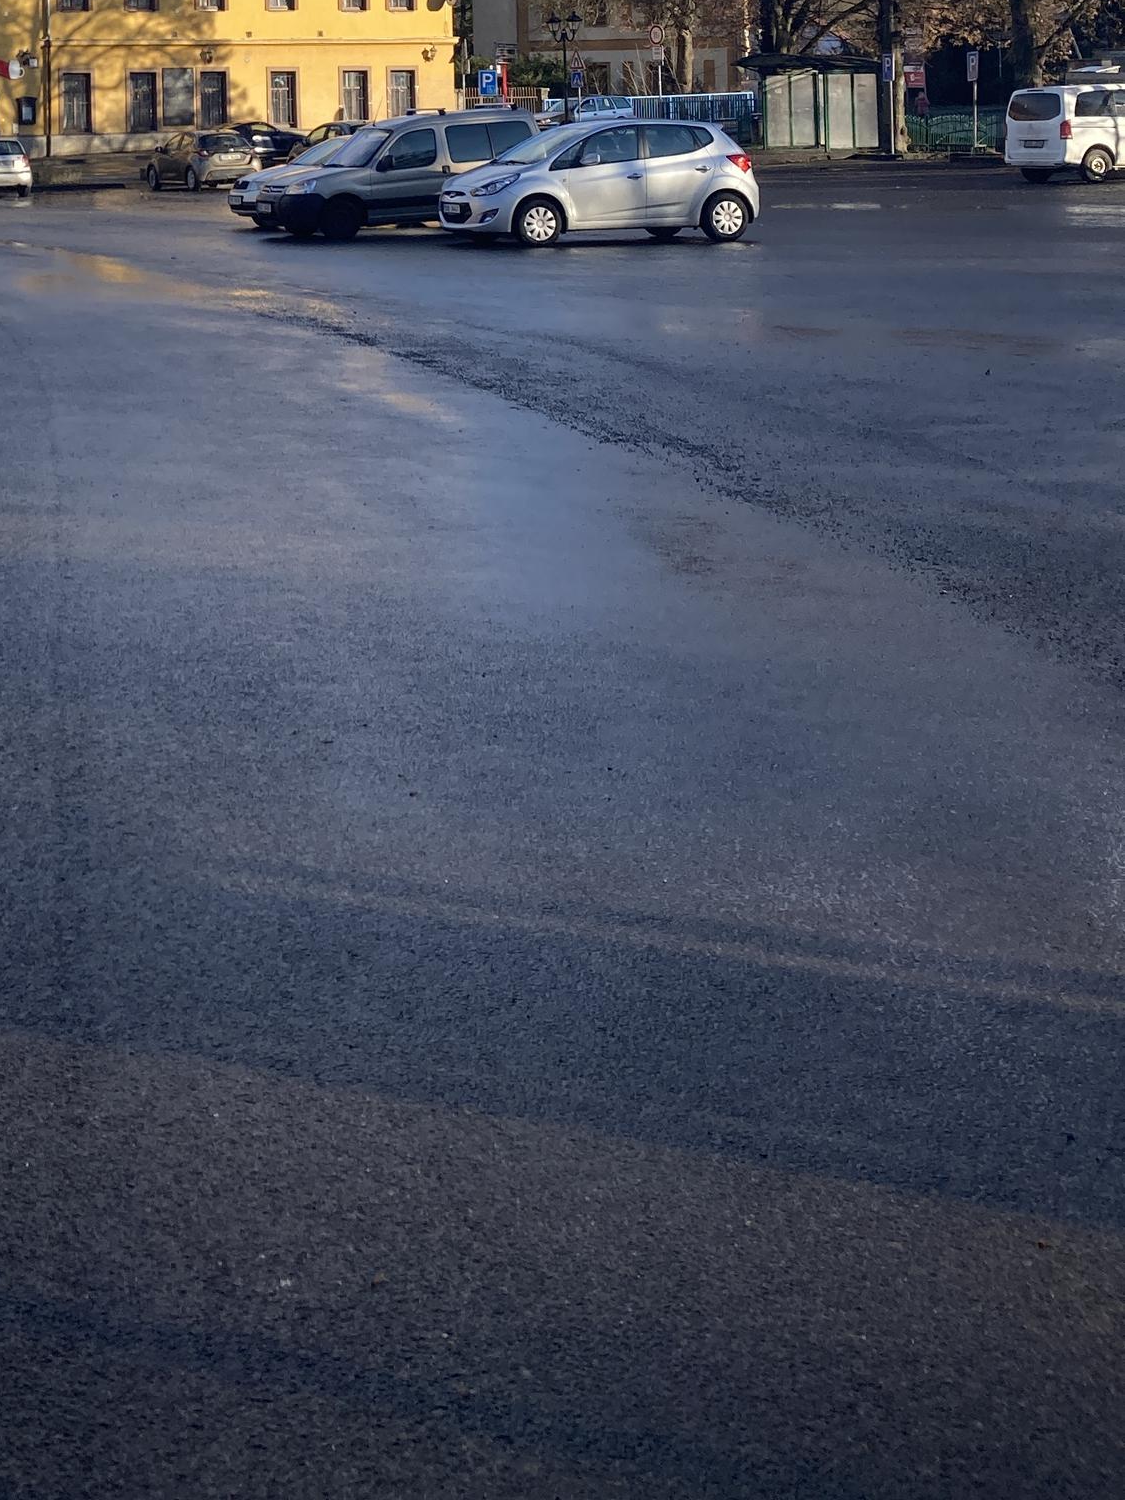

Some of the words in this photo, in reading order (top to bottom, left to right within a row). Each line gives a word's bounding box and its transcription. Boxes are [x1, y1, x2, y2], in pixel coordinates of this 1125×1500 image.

[885, 57, 891, 72] P
[970, 56, 976, 72] P
[482, 73, 493, 88] P
